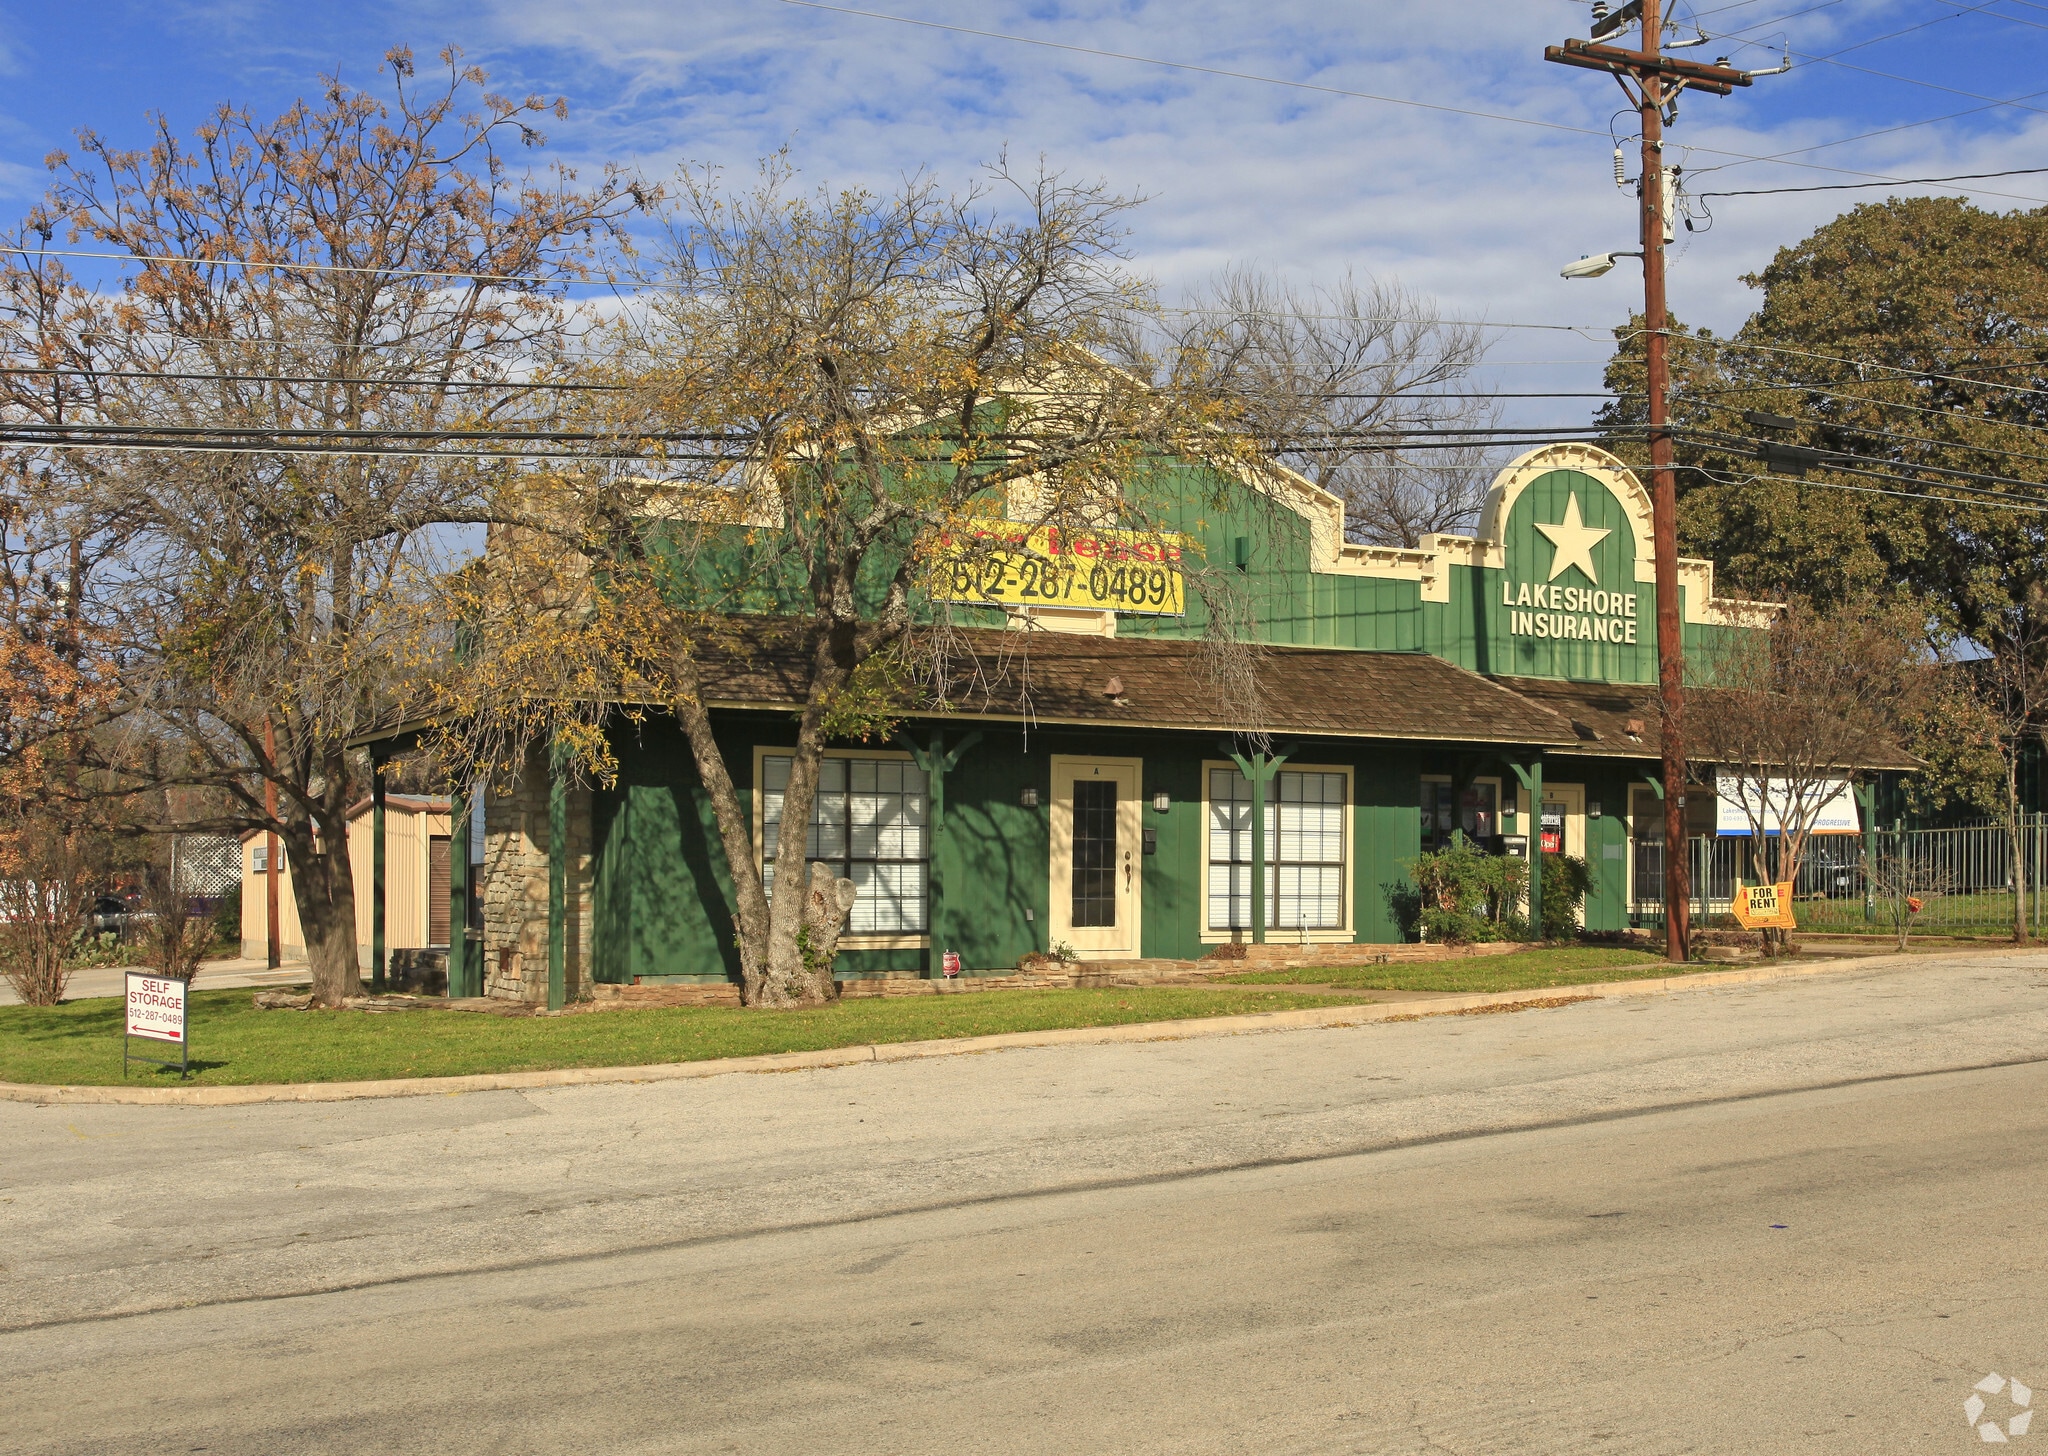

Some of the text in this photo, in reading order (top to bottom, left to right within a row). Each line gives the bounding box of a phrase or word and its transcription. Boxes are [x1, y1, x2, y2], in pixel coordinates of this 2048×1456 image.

[1503, 581, 1637, 618] LAKESHORE
[1510, 610, 1637, 644] INSURANCE
[1093, 767, 1099, 775] A
[1813, 819, 1851, 827] PROGRESSIVE
[1753, 887, 1773, 899] FOR
[1750, 898, 1777, 909] RENT
[142, 979, 170, 994] SELF
[129, 991, 182, 1010] STORAGE
[129, 1007, 182, 1025] 512-287-0489
